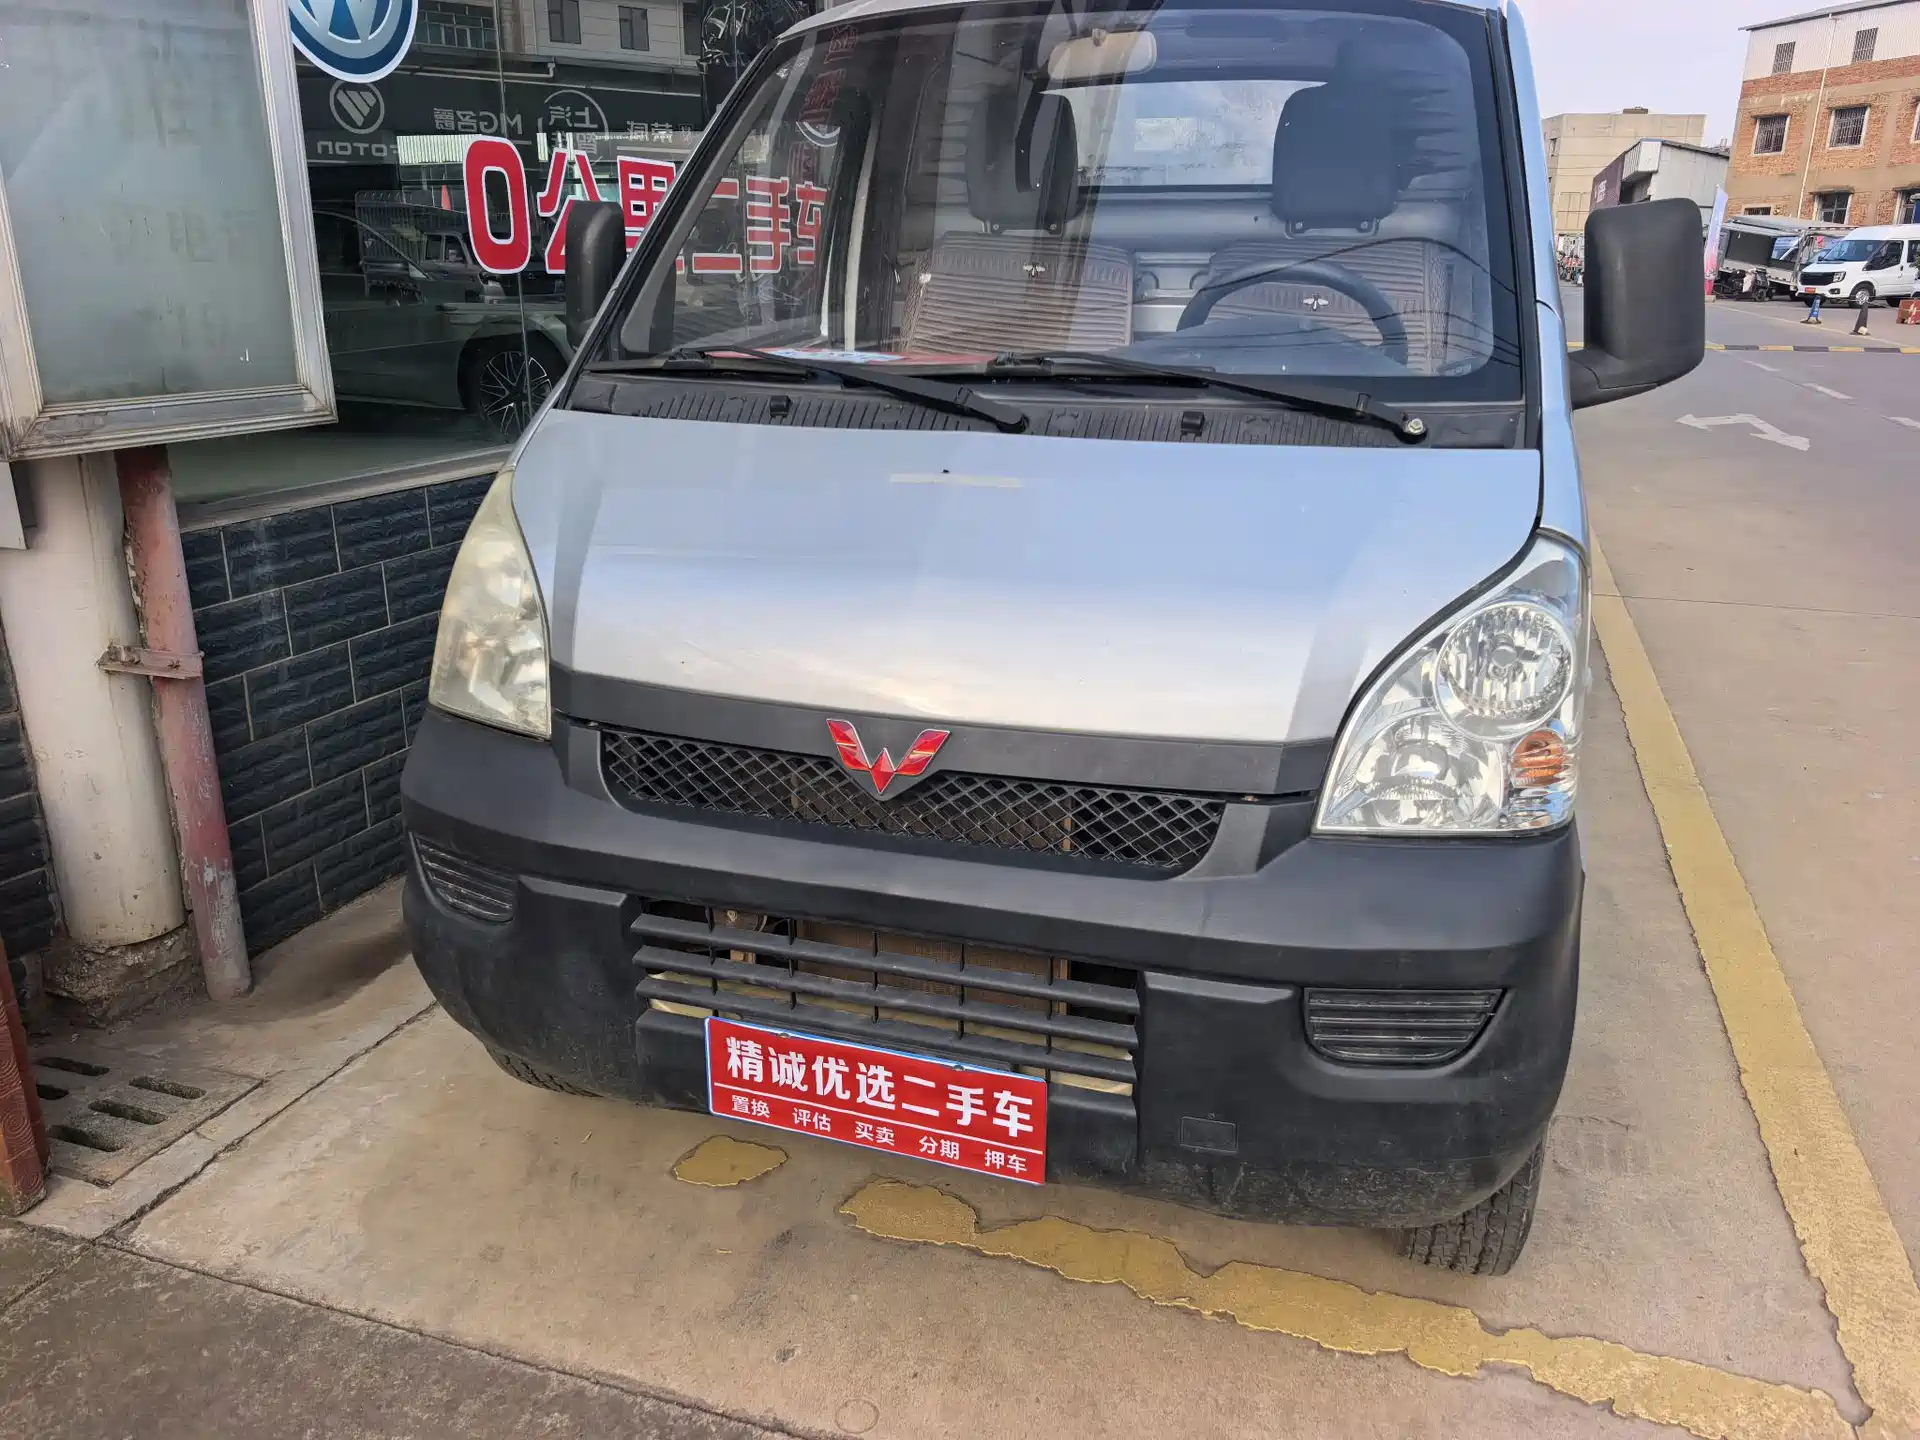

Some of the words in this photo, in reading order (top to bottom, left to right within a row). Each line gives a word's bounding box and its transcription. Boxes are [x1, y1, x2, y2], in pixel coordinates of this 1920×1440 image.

[725, 1036, 1035, 1138] 精诚优选二手车
[731, 1094, 771, 1119] 置换
[792, 1107, 832, 1132] 评估
[855, 1121, 895, 1146] 买卖
[918, 1136, 960, 1160] 分期
[984, 1149, 1028, 1174] 押车
